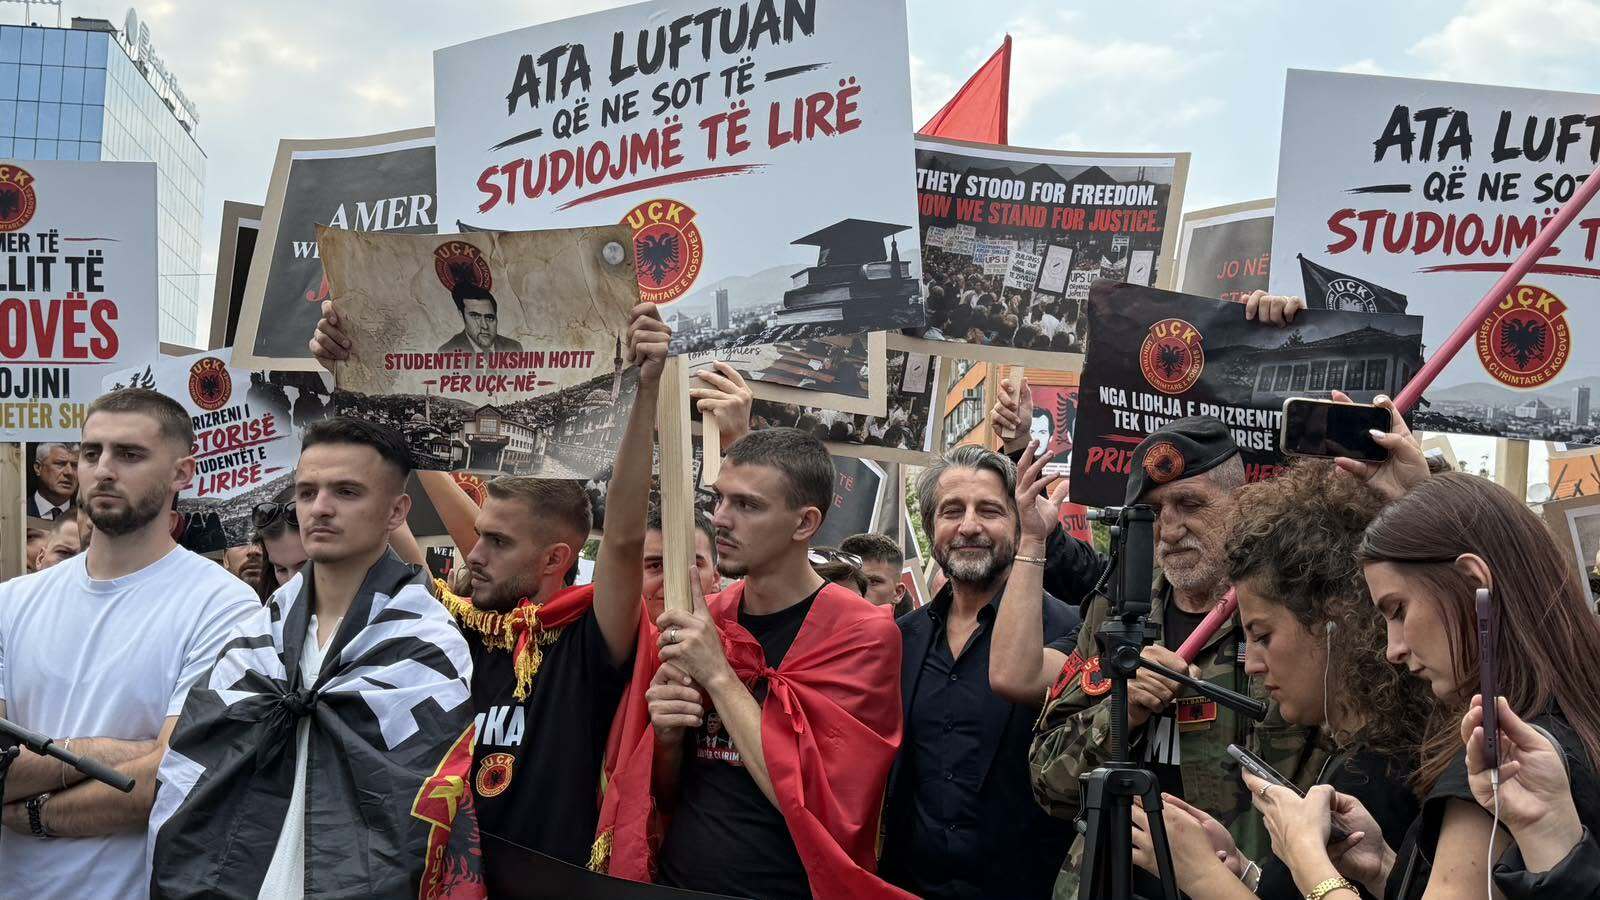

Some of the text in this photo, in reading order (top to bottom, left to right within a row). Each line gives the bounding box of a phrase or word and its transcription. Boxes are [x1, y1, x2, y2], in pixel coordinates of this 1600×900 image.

[505, 0, 816, 117] ATA LUFTUAN
[552, 56, 755, 139] QË NE SOT TË
[476, 76, 862, 214] STUDIOJMË TË LIRË
[1373, 104, 1600, 164] ATA LUFT
[916, 168, 1158, 206] THEY STOOD FOR FREEDOM.
[1423, 165, 1467, 203] QË
[1477, 172, 1521, 202] NE
[328, 194, 438, 232] AMER
[627, 202, 685, 230] UÇK
[956, 198, 985, 222] WE
[988, 202, 1048, 229] STAND
[1051, 206, 1086, 231] FOR
[1088, 208, 1161, 233] JUSTICE.
[37, 229, 59, 253] TË
[65, 249, 104, 293] TË
[1217, 253, 1270, 280] JO NË
[639, 285, 683, 301] RIMTARE
[0, 292, 119, 360] OVËS
[1155, 320, 1197, 345] UÇK
[193, 358, 221, 374] UÇK
[384, 349, 595, 370] STUDENTËT E UKSHIN HOTIT
[1545, 368, 1553, 377] E
[0, 367, 70, 399] OJINI
[439, 371, 537, 397] PËR UÇK-NË
[0, 398, 88, 429] ETËR SH
[245, 404, 250, 418] I
[1099, 386, 1127, 408] NGA
[1132, 391, 1183, 418] LIDHJA
[1199, 402, 1283, 430] PRIZRENIT
[1112, 409, 1141, 431] TEK
[260, 446, 267, 460] E
[197, 458, 262, 497] LIRISË
[433, 546, 447, 556] WE
